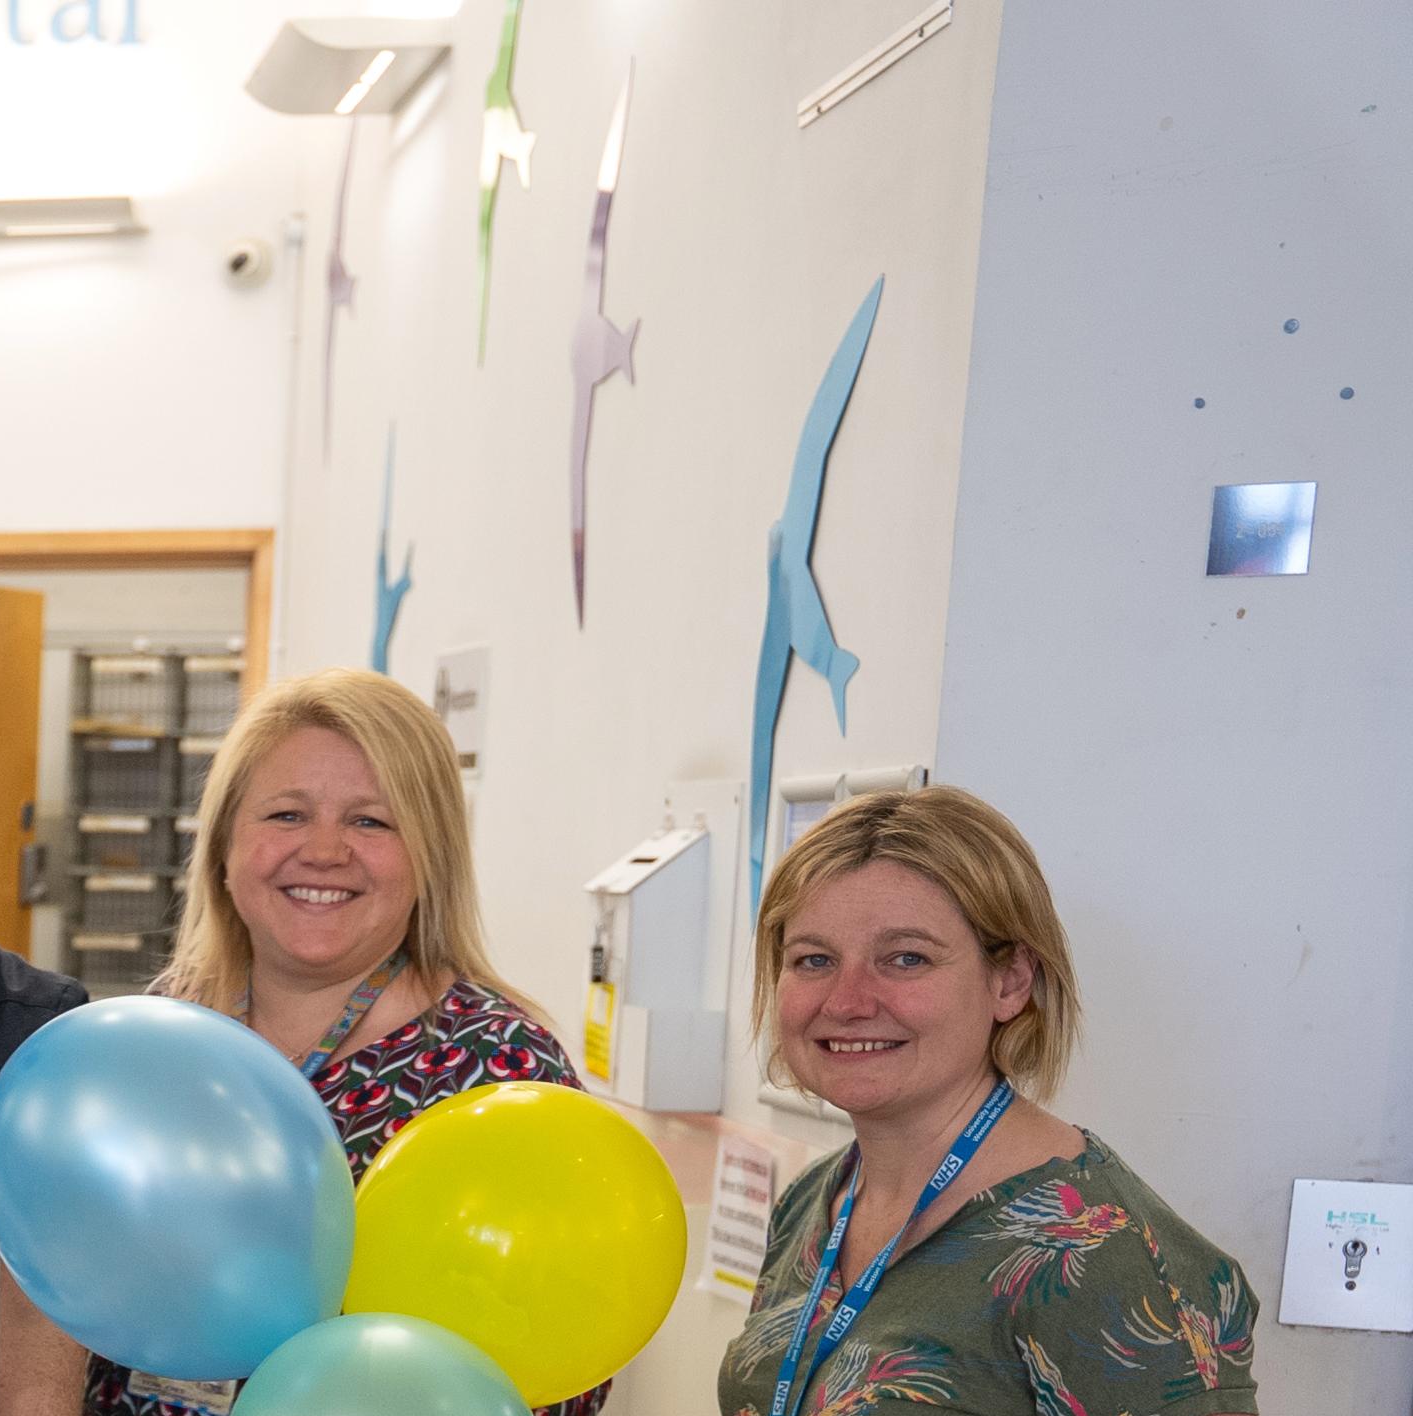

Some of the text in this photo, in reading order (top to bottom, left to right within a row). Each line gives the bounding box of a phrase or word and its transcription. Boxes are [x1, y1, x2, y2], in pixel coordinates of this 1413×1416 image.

[933, 1156, 960, 1189] NHS
[829, 1220, 846, 1249] NHS
[829, 1307, 853, 1340] NHS
[773, 1382, 789, 1414] NHS
